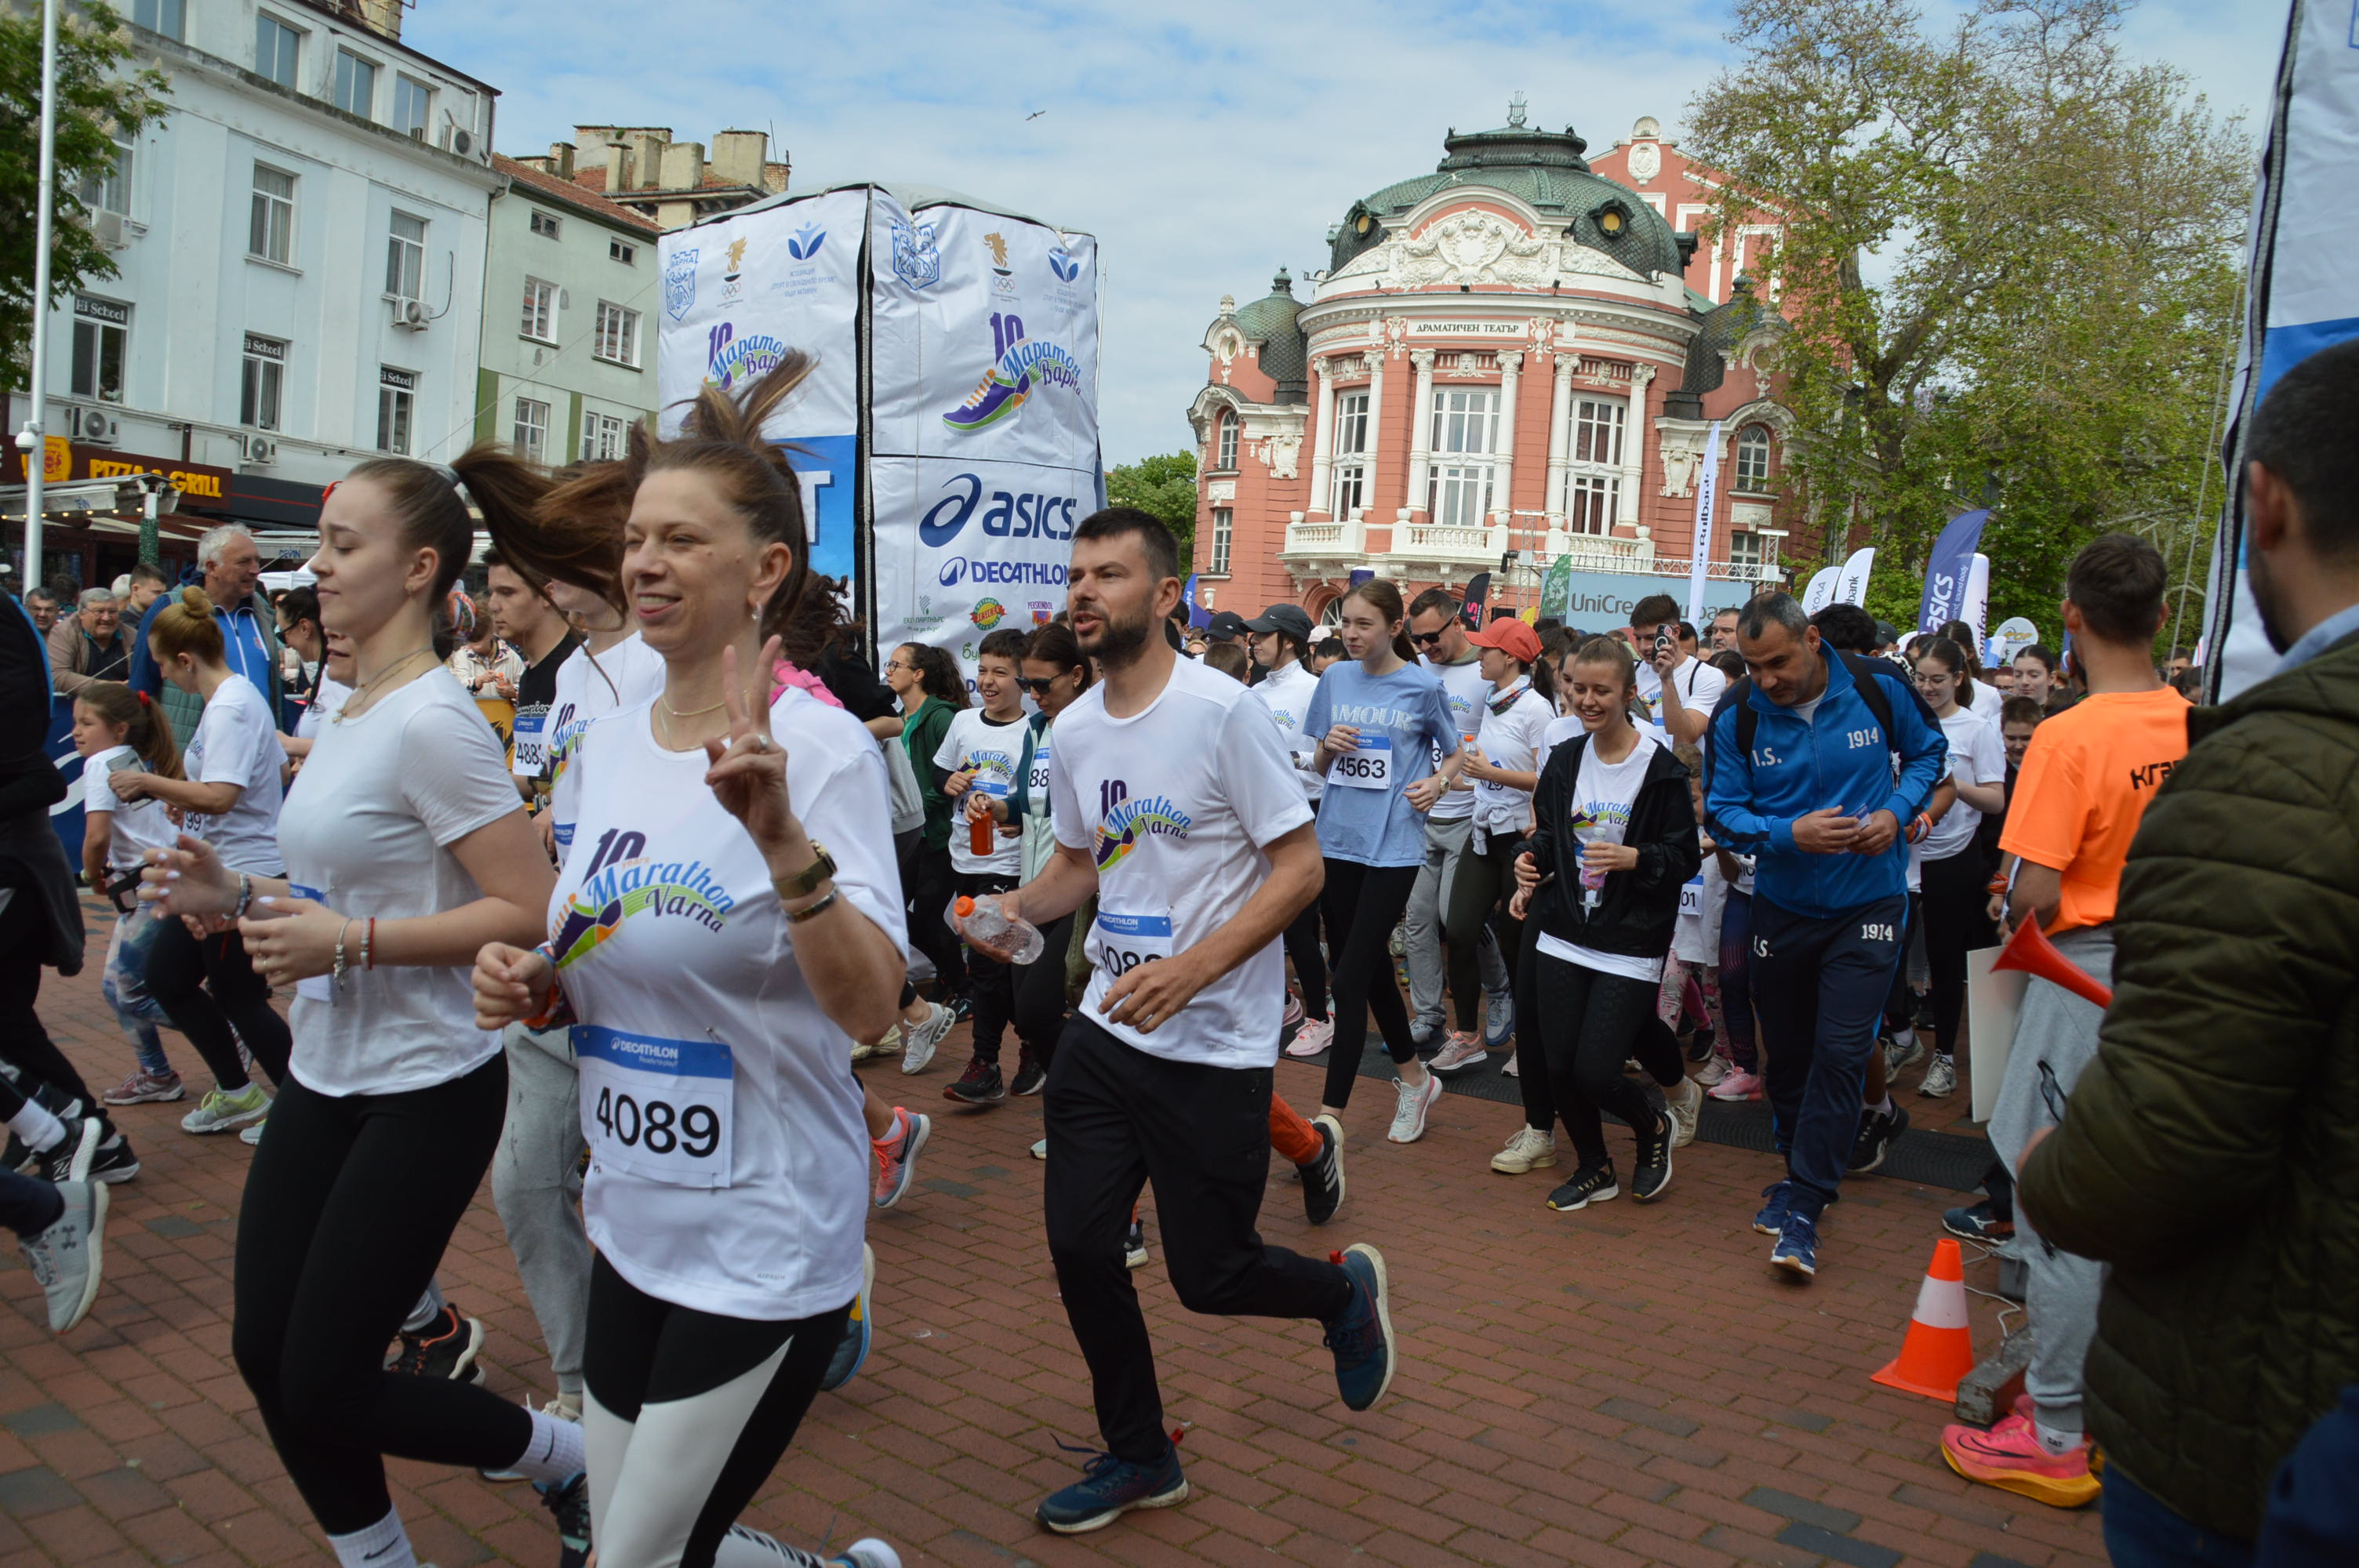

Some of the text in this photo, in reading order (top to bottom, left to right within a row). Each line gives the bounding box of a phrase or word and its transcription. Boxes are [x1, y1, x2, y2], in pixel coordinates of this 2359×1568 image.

[90, 303, 125, 321] School
[990, 311, 1024, 366] 10
[1416, 324, 1519, 333] ДРАМАТИЧЕН ТЕАТЪР
[253, 340, 282, 357] School
[1003, 341, 1081, 384] Маратон
[387, 372, 412, 387] School
[1039, 359, 1081, 396] Варна
[169, 470, 223, 499] GRILL
[982, 491, 1078, 541] asics
[1449, 704, 1470, 714] arna
[1846, 727, 1880, 749] 1914
[1336, 757, 1386, 779] 4563
[1107, 795, 1192, 837] Marathon
[1139, 814, 1188, 840] Varna
[582, 828, 646, 888] 10
[587, 860, 735, 914] Marathon
[645, 885, 724, 934] Varna
[1101, 915, 1139, 925] DECATHLON
[1861, 924, 1894, 942] 1914
[620, 1040, 678, 1059] DECATHLON
[596, 1086, 721, 1159] 4089
